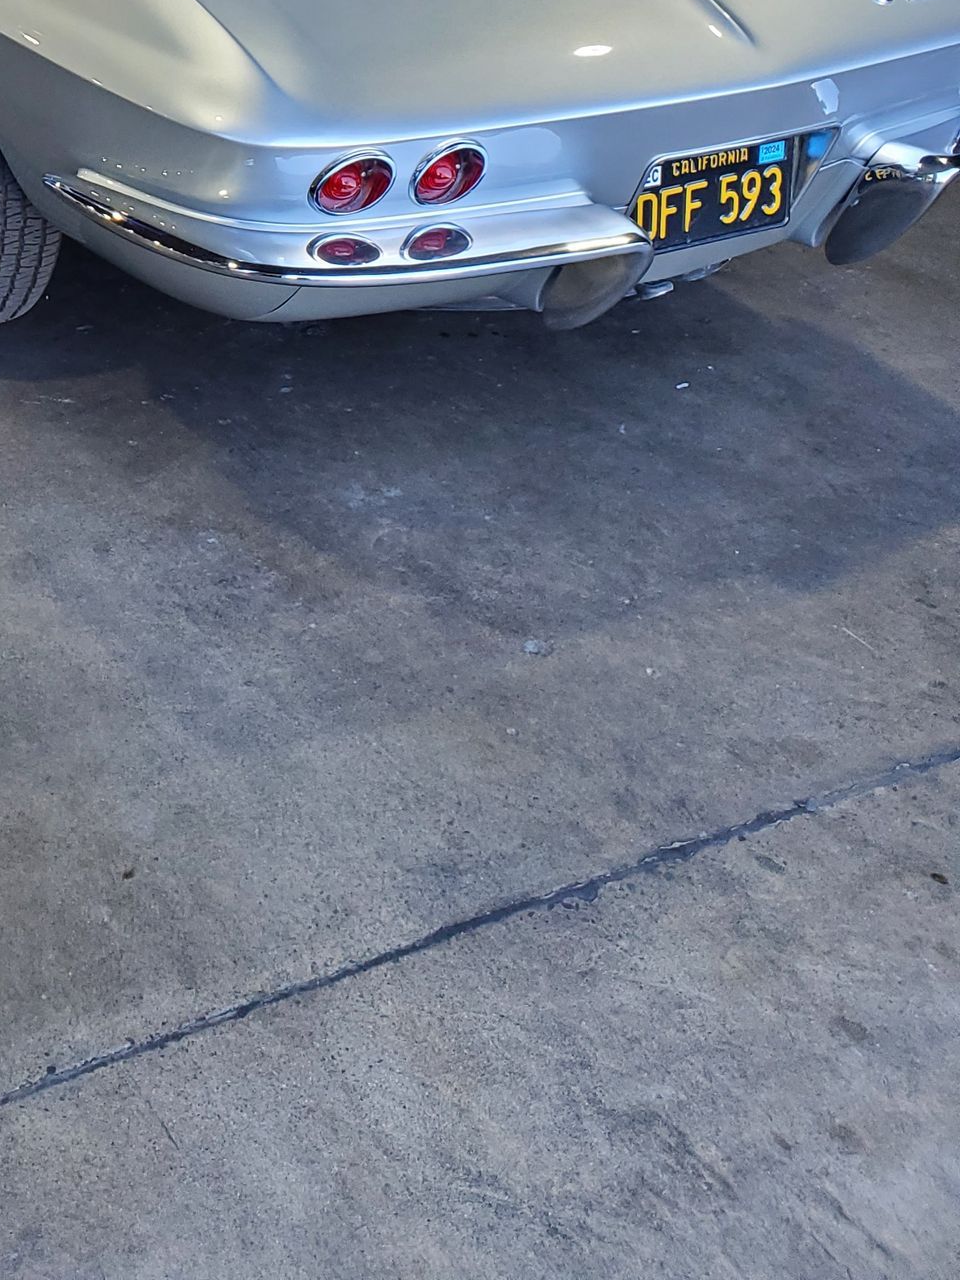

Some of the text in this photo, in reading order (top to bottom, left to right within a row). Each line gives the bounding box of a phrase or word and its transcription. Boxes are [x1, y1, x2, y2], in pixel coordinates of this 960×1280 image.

[672, 144, 781, 177] CALIFORNIA 2024
[720, 165, 782, 224] 593
